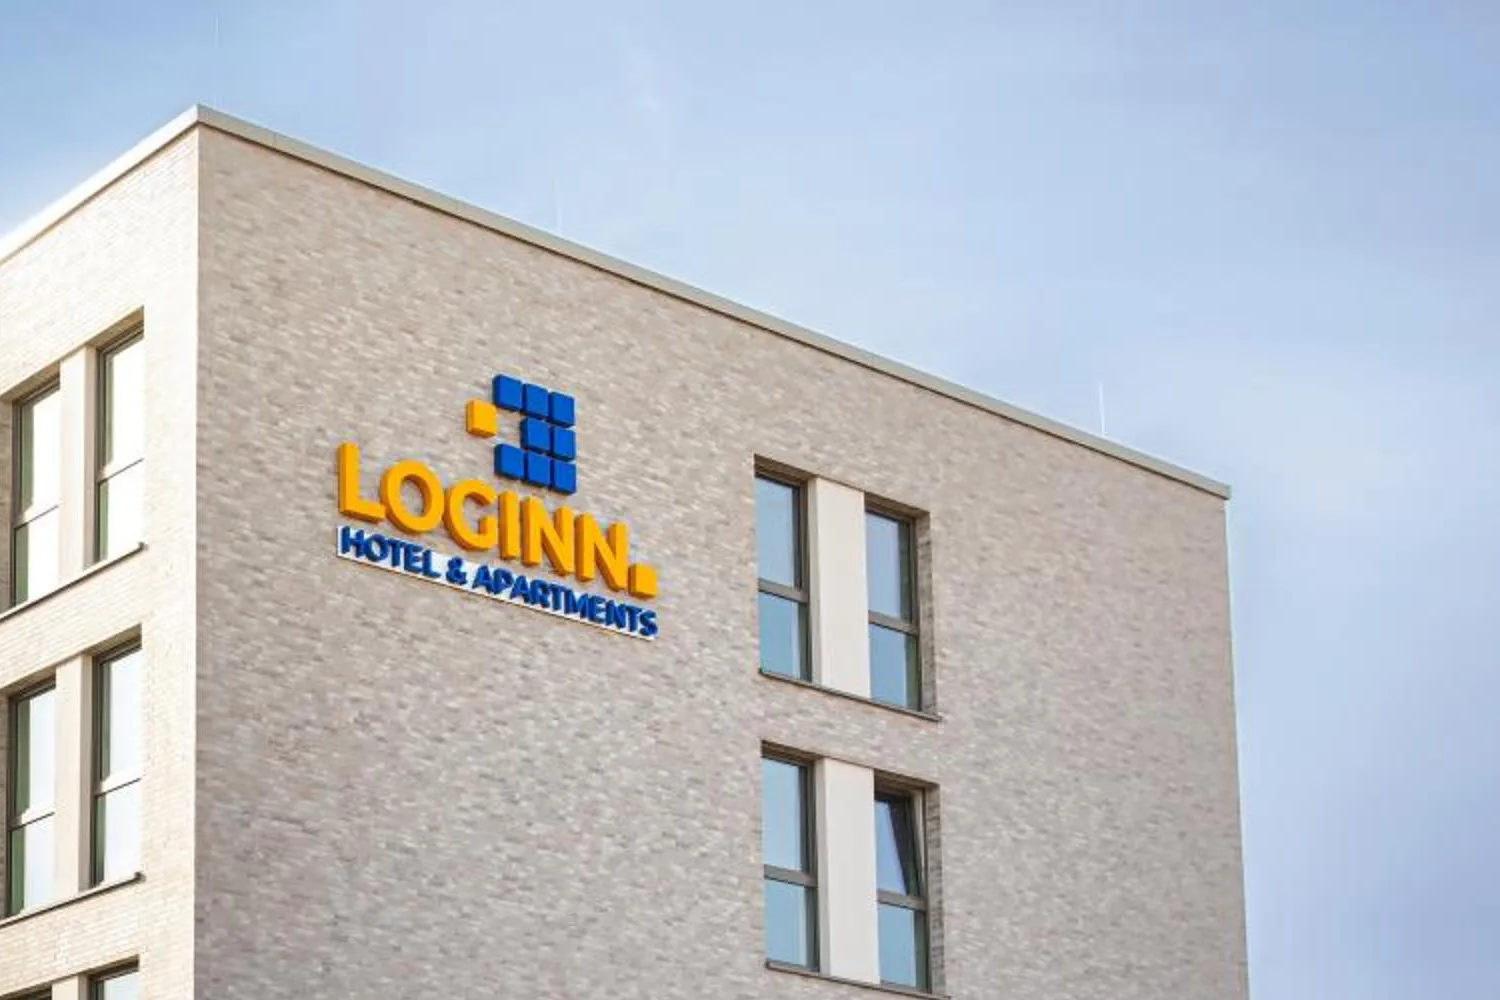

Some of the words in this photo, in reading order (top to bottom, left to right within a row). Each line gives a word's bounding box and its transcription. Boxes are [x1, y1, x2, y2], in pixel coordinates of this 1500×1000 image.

[340, 526, 440, 578] HOTEL
[446, 557, 467, 585] &
[472, 565, 658, 638] APARTMENTS
